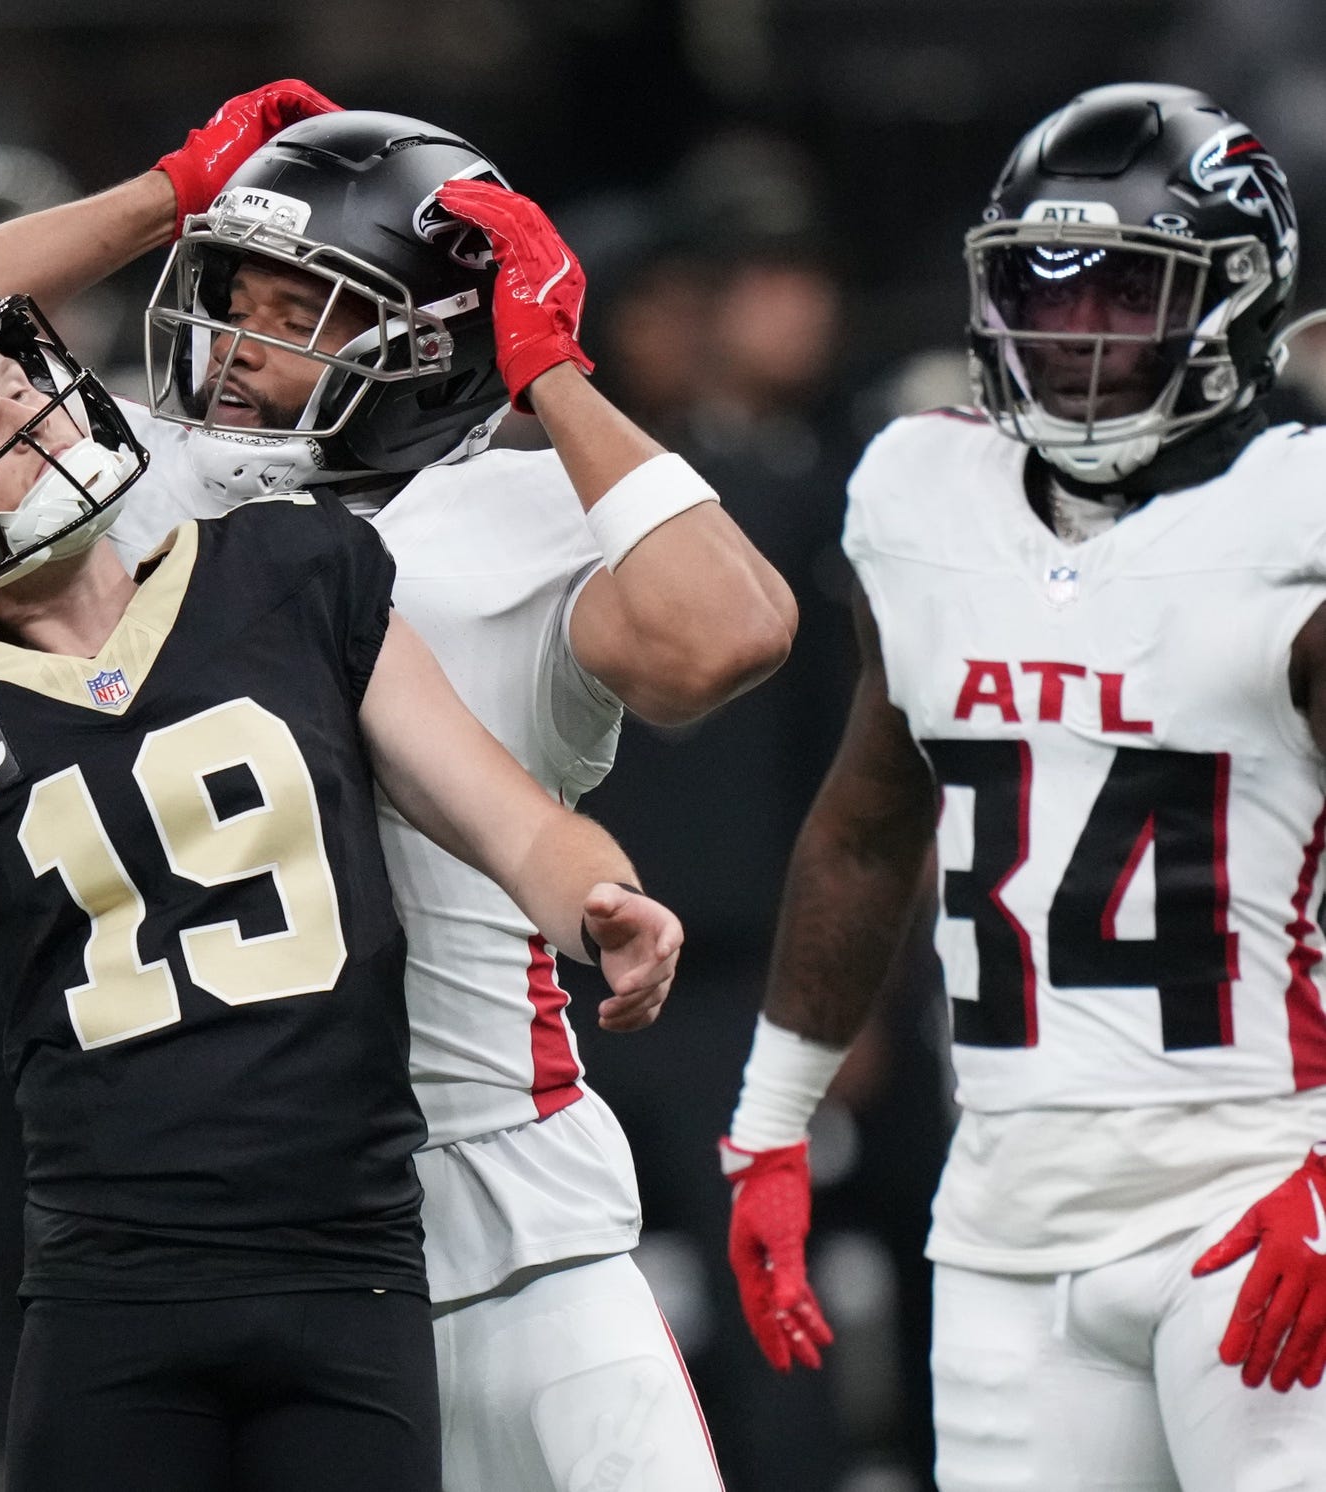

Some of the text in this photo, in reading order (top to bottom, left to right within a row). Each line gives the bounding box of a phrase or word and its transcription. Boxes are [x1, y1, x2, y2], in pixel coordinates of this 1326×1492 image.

[242, 194, 273, 209] ATL
[1042, 207, 1091, 223] ATL
[96, 683, 126, 702] NFL
[954, 658, 1154, 734] ATL
[17, 696, 348, 1051] 19
[919, 739, 1241, 1052] 34
